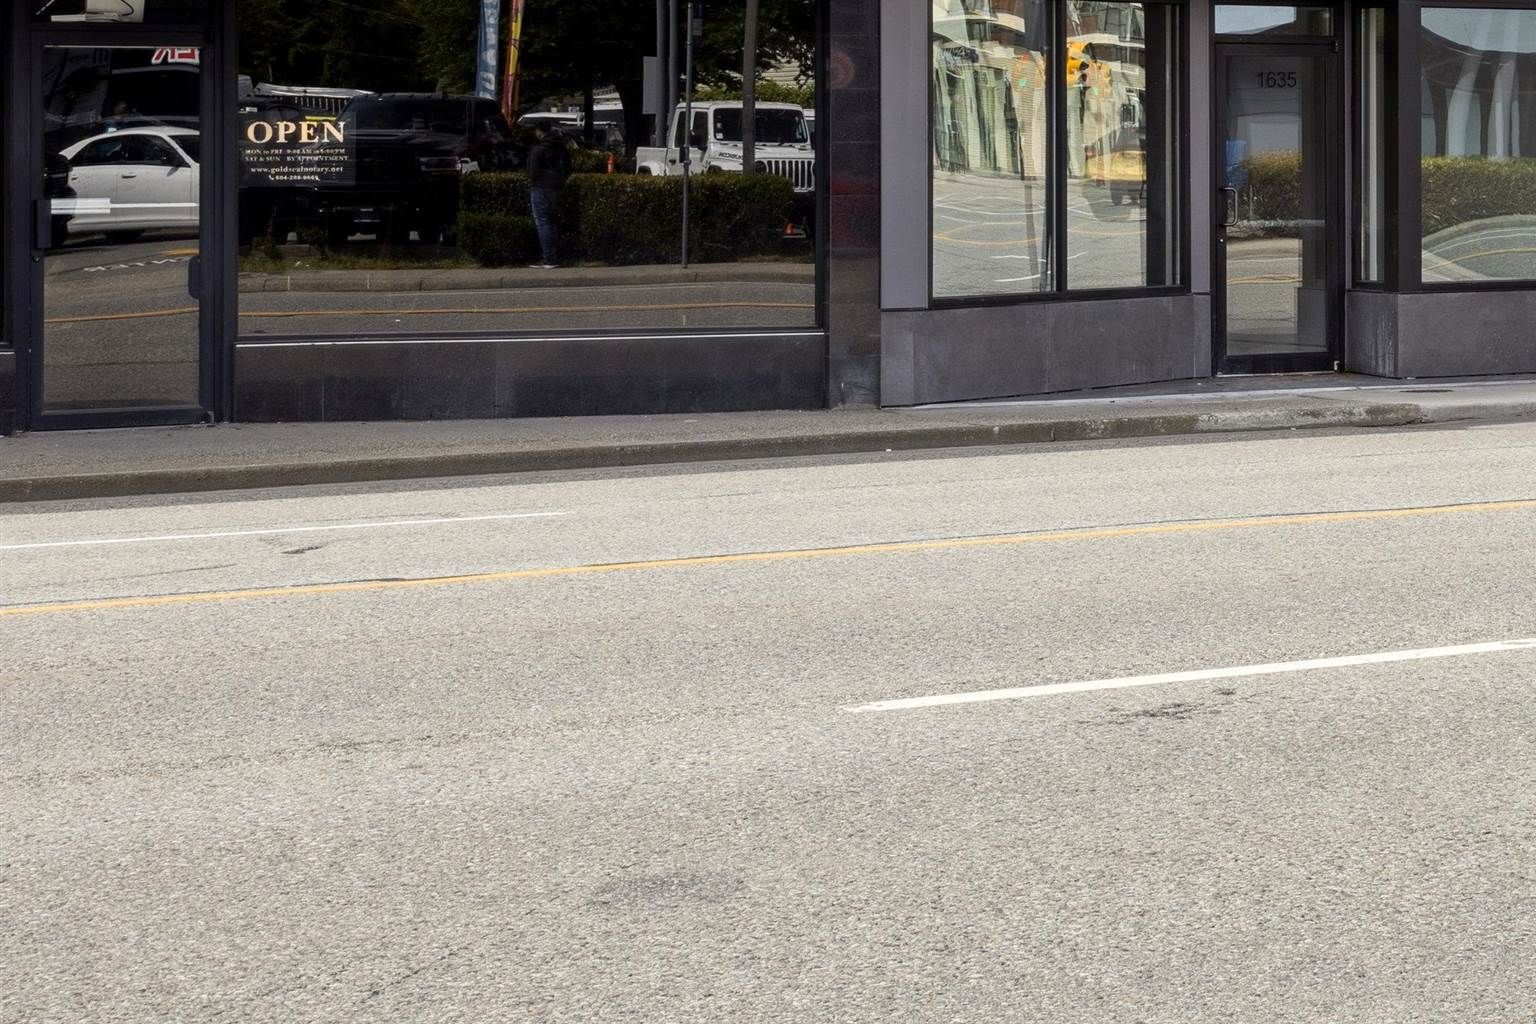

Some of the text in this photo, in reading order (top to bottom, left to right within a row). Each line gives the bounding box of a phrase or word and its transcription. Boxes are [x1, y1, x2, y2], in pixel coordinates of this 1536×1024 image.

[1256, 71, 1297, 88] 1635
[246, 120, 346, 144] OPEN
[250, 165, 344, 175] www.goldsealnotary.net
